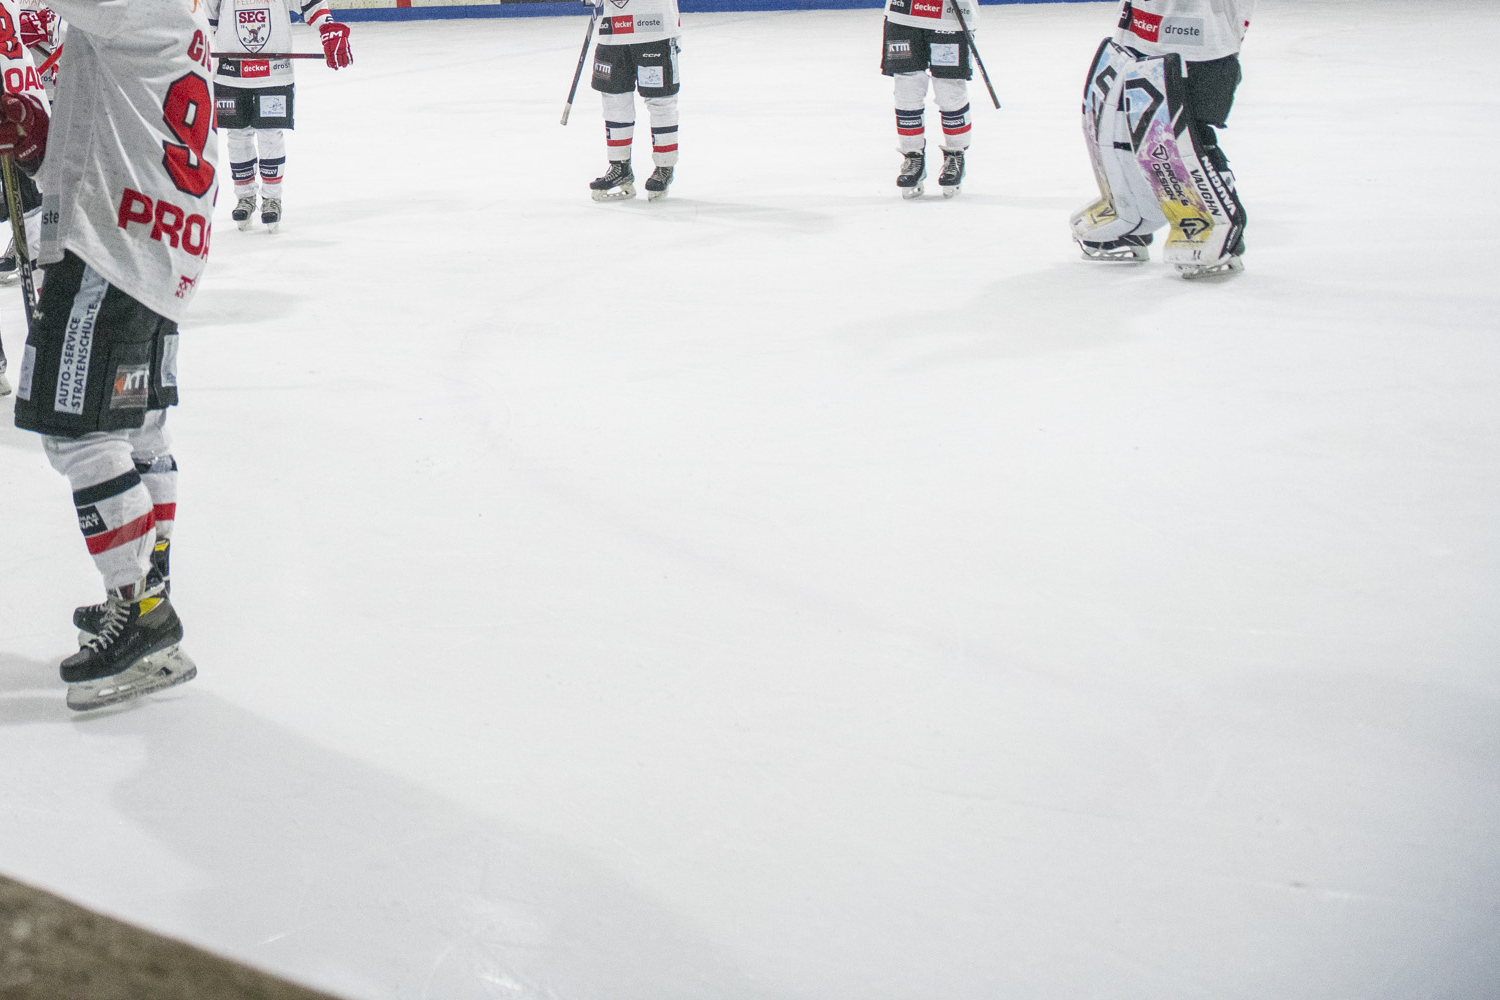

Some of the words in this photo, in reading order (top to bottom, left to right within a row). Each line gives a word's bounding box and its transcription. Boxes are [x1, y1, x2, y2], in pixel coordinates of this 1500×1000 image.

[914, 2, 941, 13] decker
[946, 6, 970, 15] drste
[238, 11, 266, 23] SEG
[614, 21, 632, 29] decker
[1165, 24, 1200, 36] droste
[889, 43, 910, 52] KTM
[243, 64, 268, 72] decker
[217, 100, 235, 109] KTM
[1151, 163, 1177, 202] DESIGN
[1162, 162, 1185, 198] DRUCK
[1201, 155, 1237, 216] VAUGHN
[1190, 169, 1222, 217] VAUGHN
[42, 209, 59, 224] ste
[57, 316, 81, 407] AUTO-SERVICE
[70, 302, 99, 409] STRATENSCHULTE
